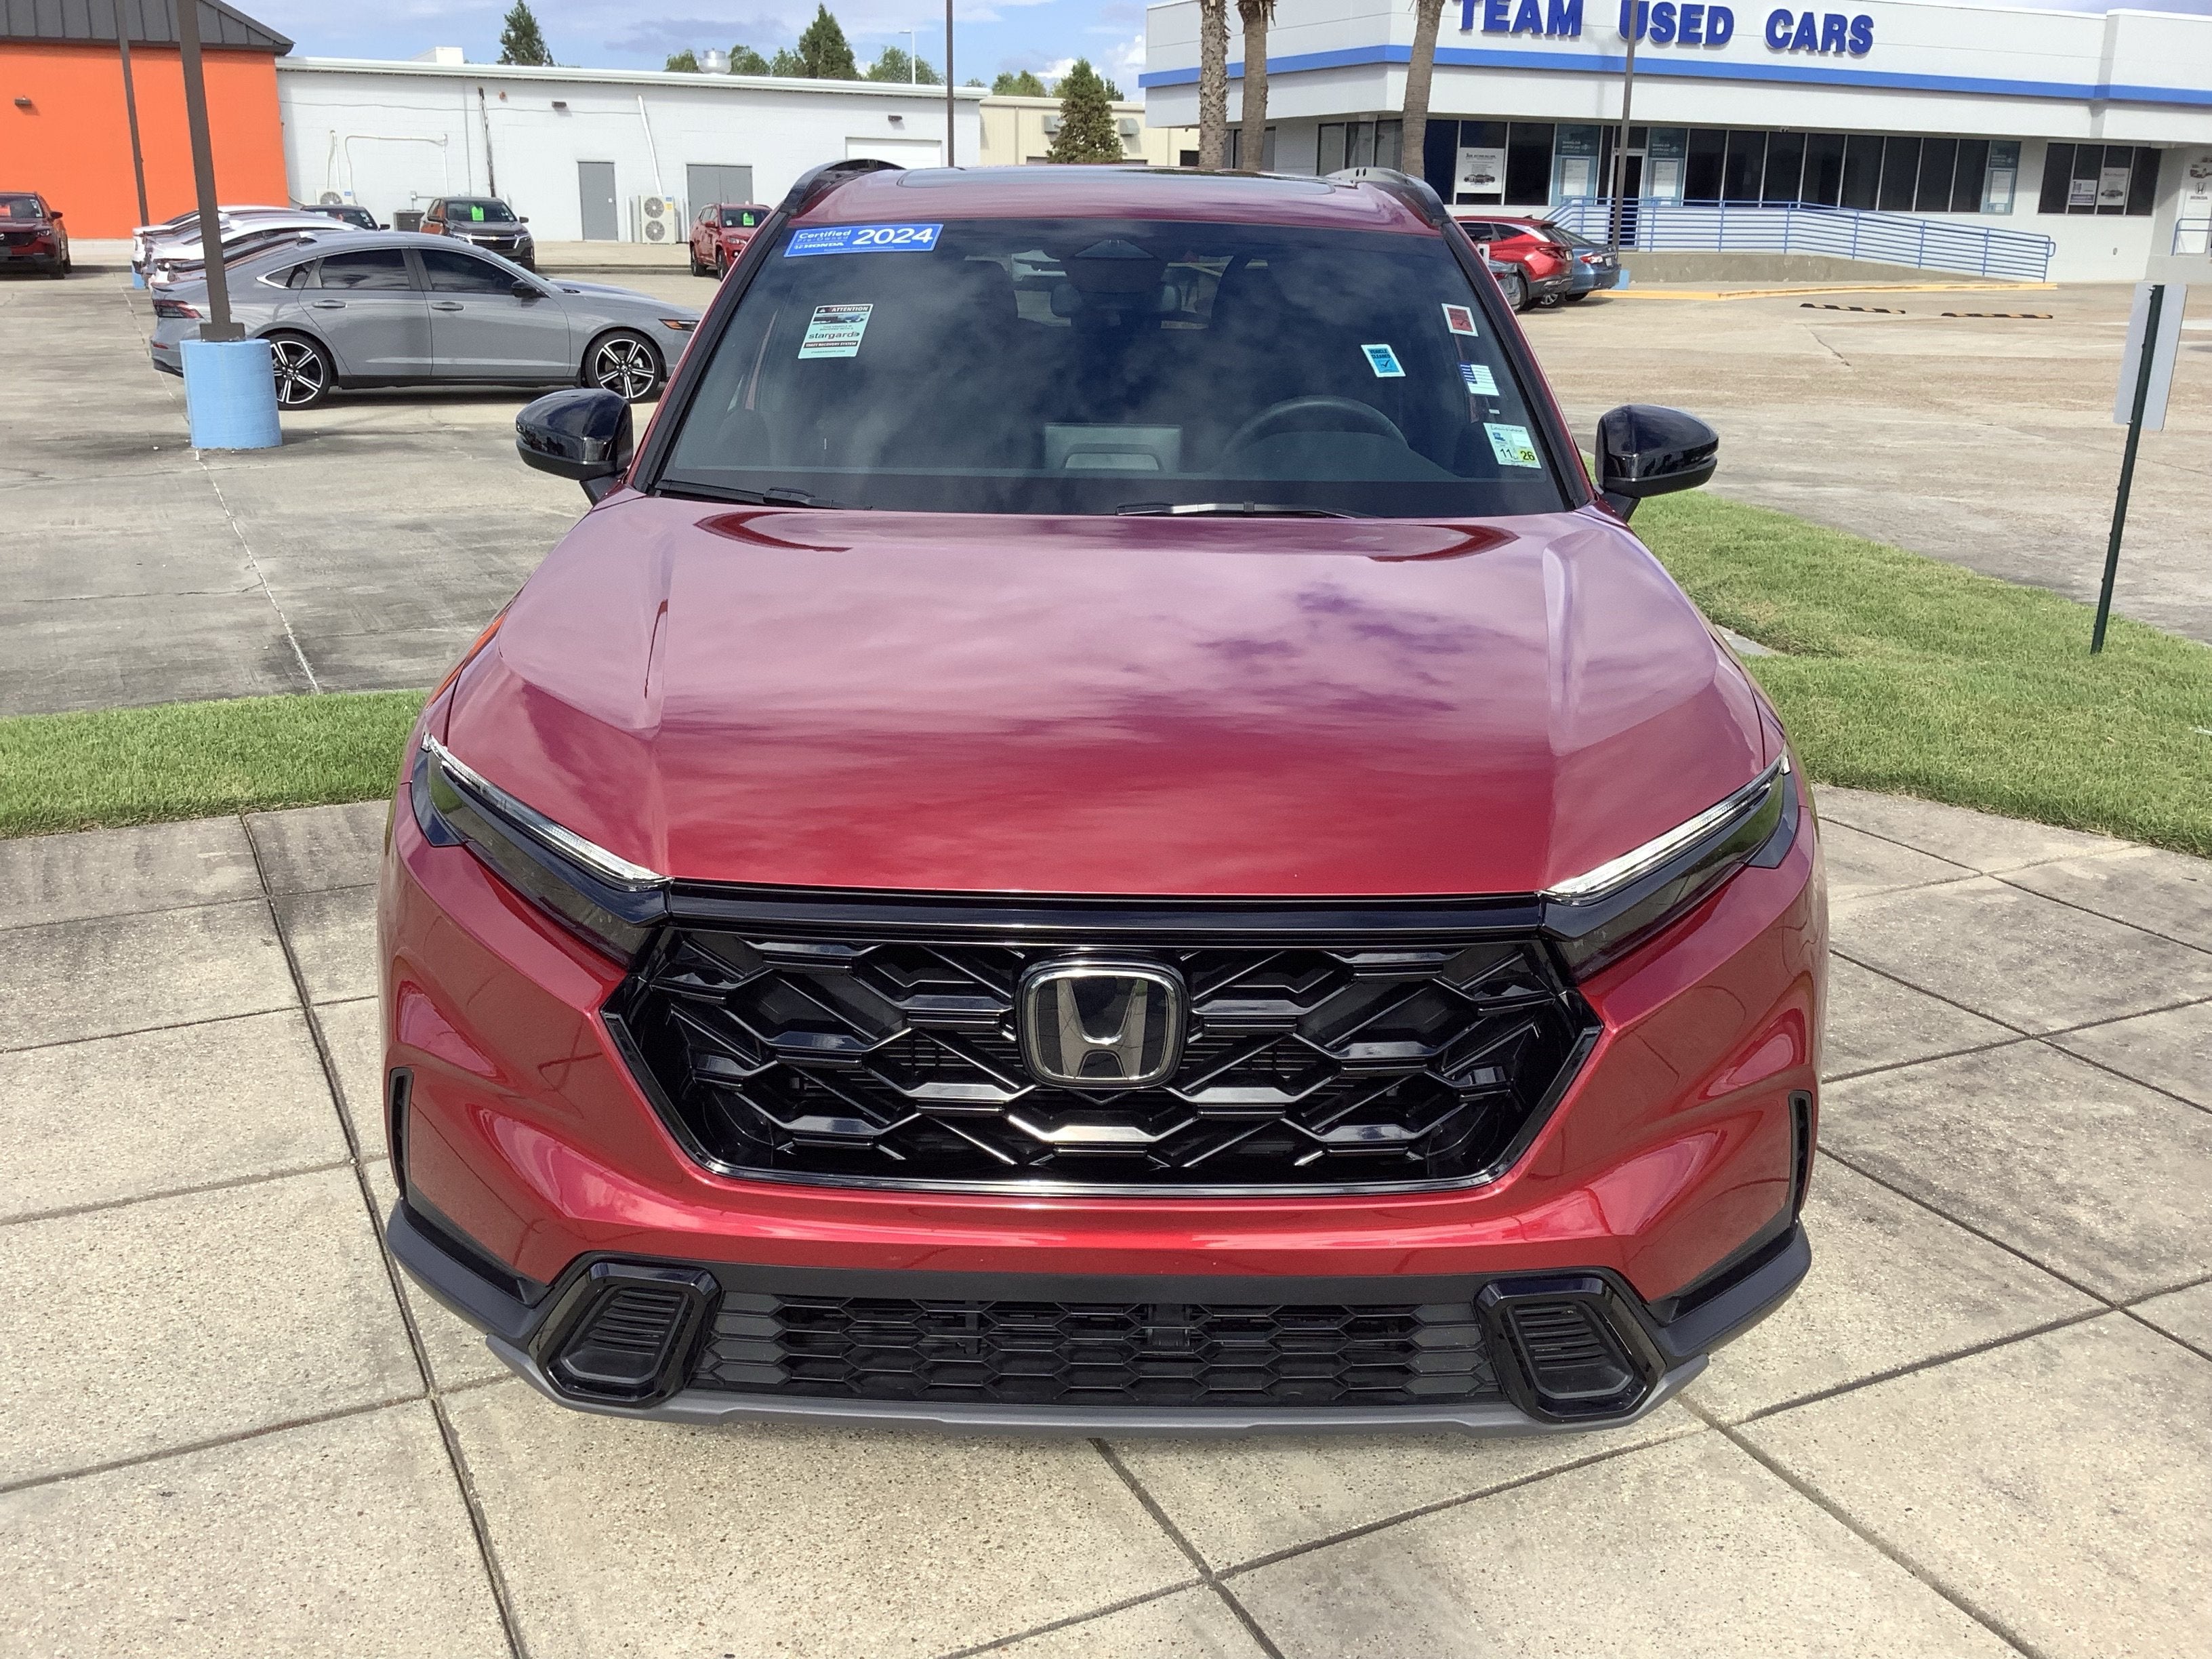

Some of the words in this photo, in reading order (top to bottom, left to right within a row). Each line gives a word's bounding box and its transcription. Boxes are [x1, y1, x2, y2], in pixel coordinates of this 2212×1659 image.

[1452, 0, 1584, 37] TEAM
[1619, 0, 1735, 45] USED
[1765, 8, 1875, 55] CARS
[799, 230, 852, 239] Certified
[852, 228, 933, 245] 2024
[1500, 448, 1513, 458] 11
[1520, 450, 1536, 461] 26
